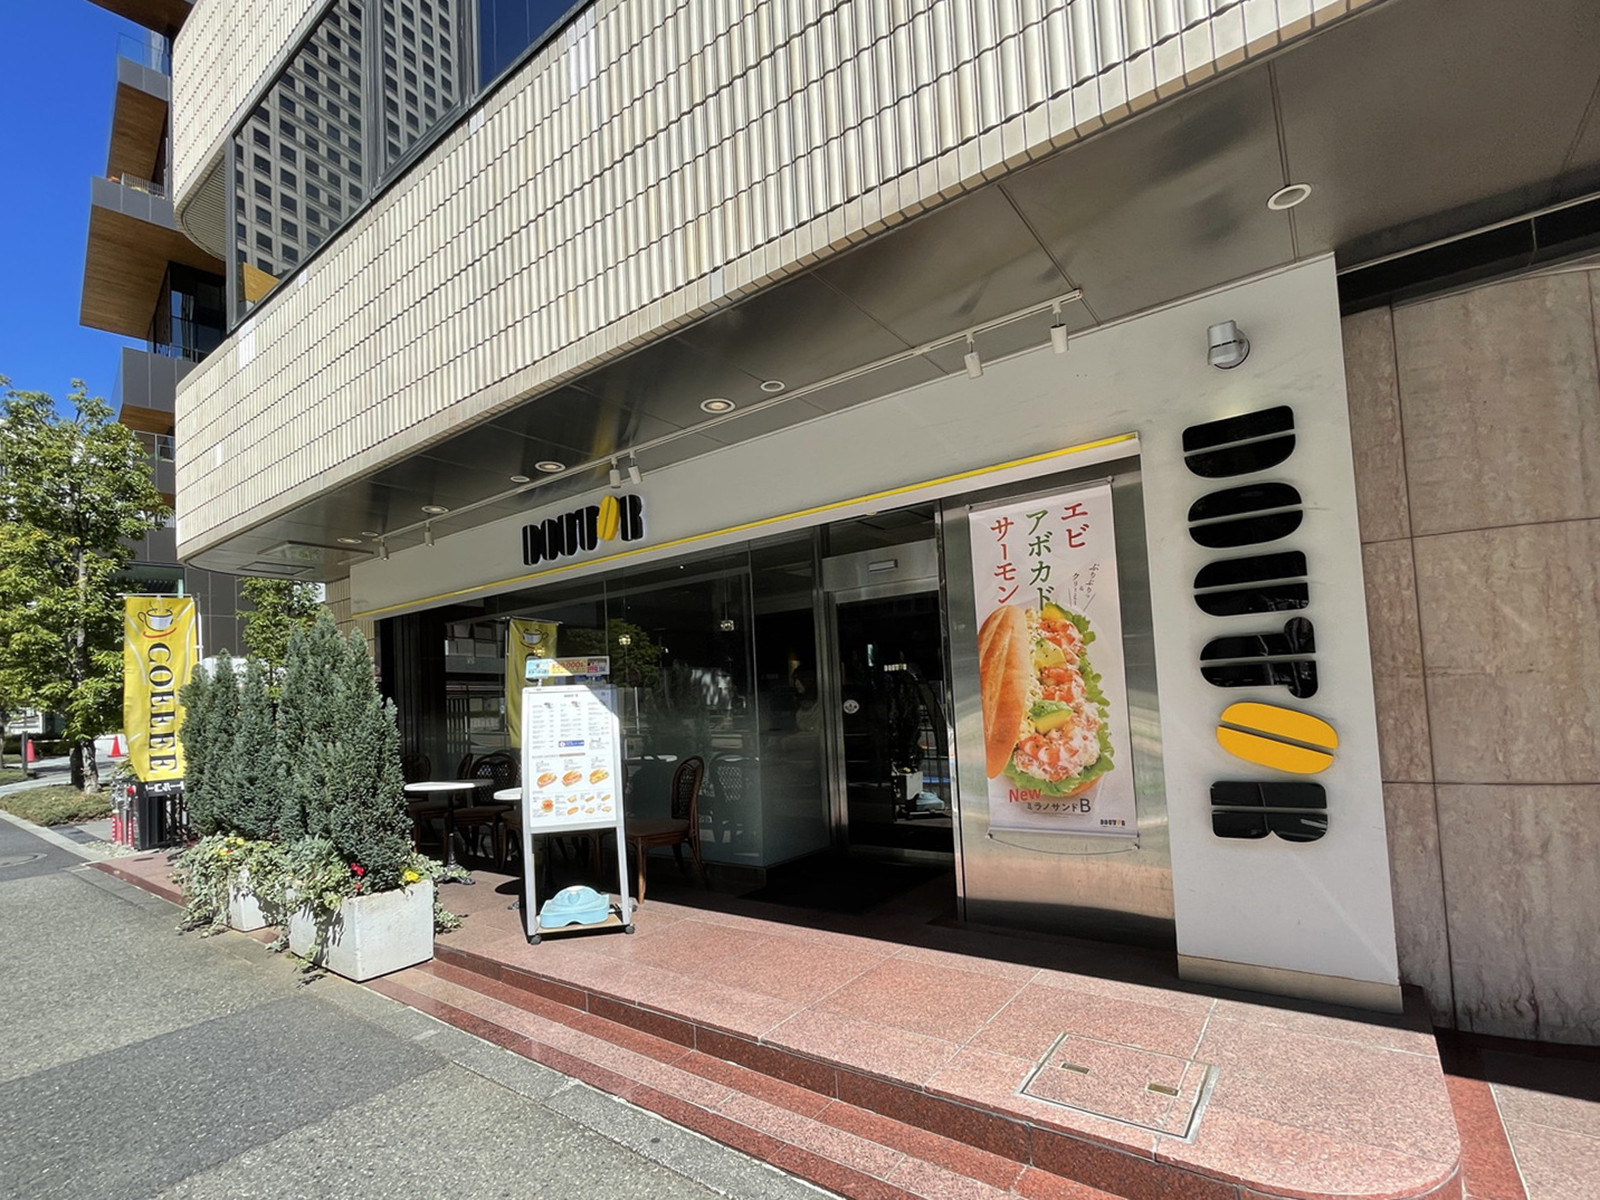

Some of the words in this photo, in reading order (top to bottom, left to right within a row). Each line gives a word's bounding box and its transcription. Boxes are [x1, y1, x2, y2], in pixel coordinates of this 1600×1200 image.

[522, 494, 644, 566] DOUTOR
[990, 517, 1020, 604] サーモン
[1026, 509, 1055, 611] アボカド
[1061, 503, 1090, 549] エビ
[1182, 405, 1339, 843] DOUTOR
[1009, 788, 1042, 803] New
